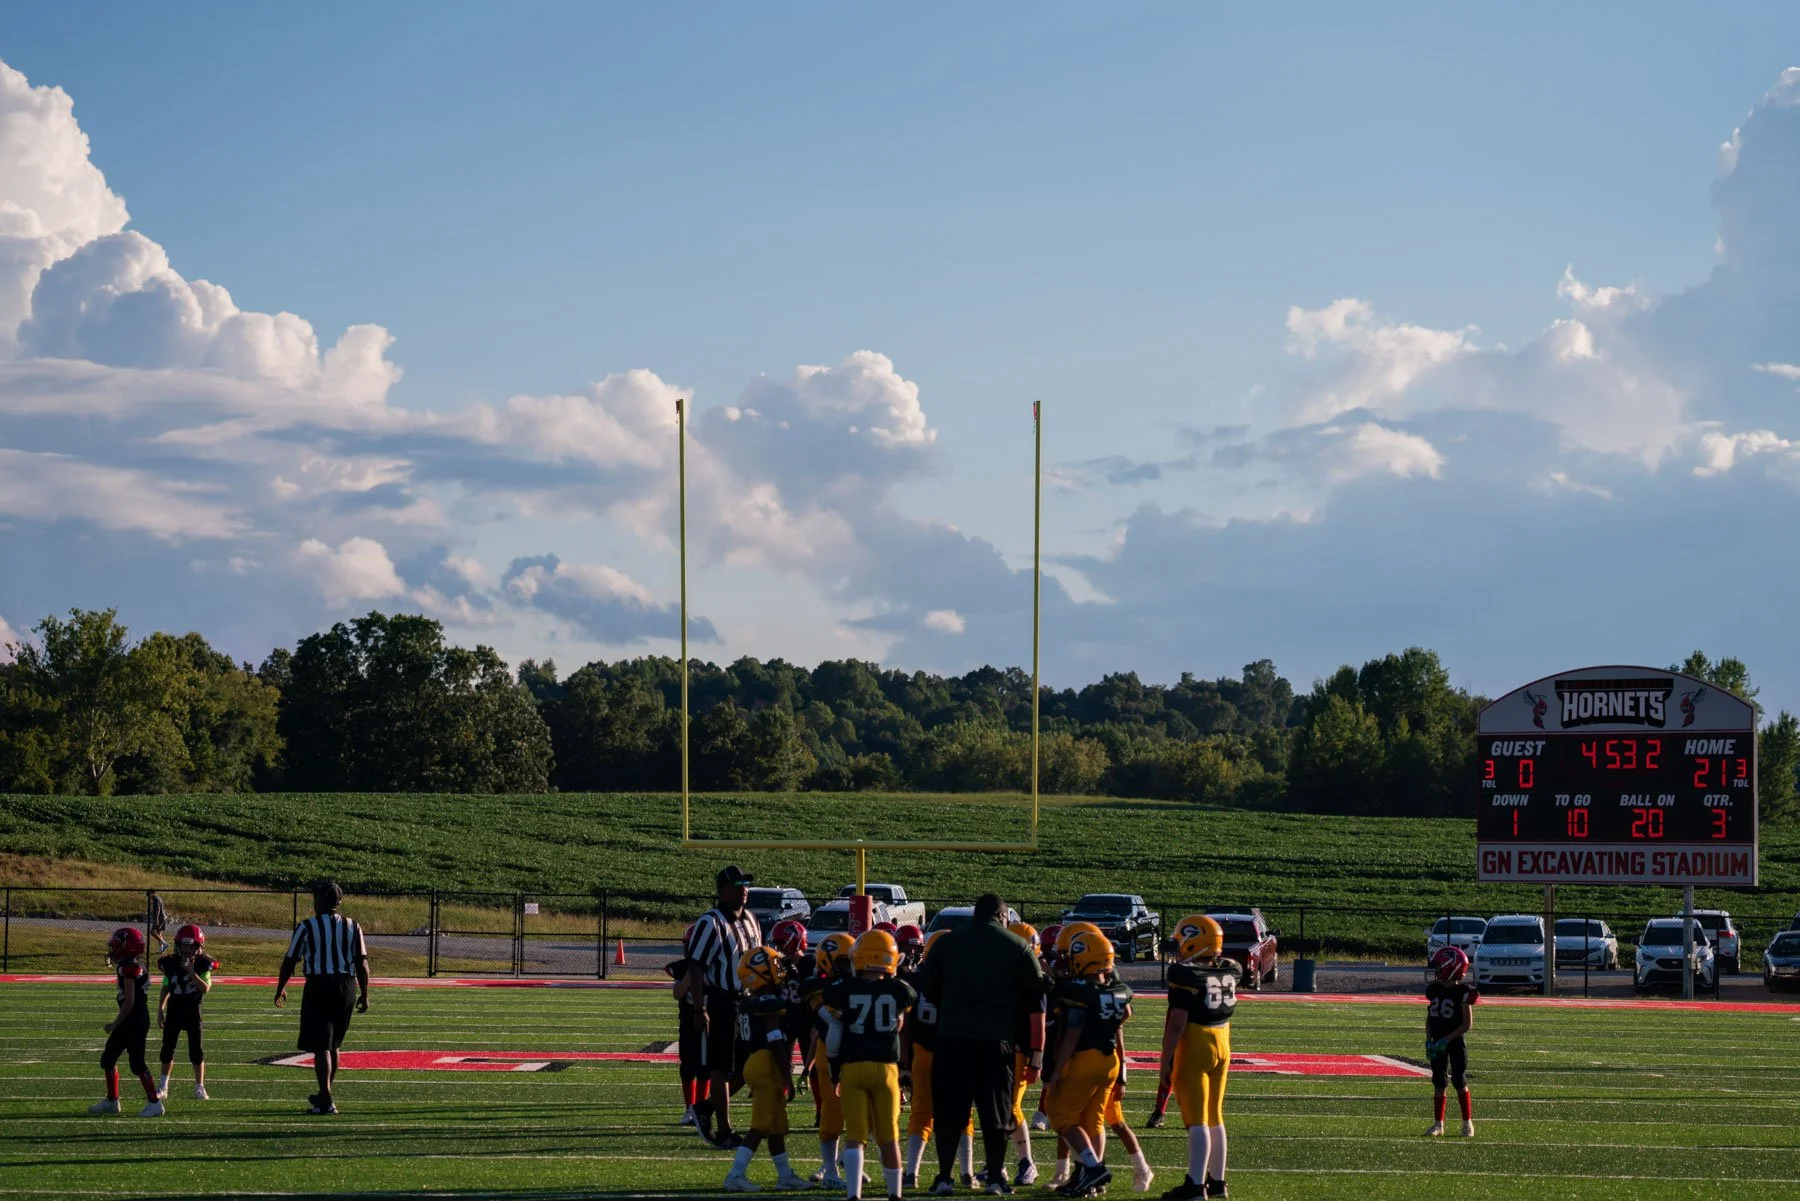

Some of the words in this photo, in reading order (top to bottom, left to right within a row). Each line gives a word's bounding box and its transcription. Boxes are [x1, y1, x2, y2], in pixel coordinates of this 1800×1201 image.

[1562, 690, 1665, 721] HORNETS
[1491, 741, 1546, 756] GUEST
[1684, 739, 1736, 755] HOME
[1485, 760, 1495, 779] 3
[1519, 759, 1534, 788] 0
[1694, 758, 1726, 788] 21
[1736, 759, 1746, 778] 3
[1481, 780, 1497, 788] TOL
[1733, 779, 1749, 788] TOL
[1492, 795, 1529, 806] DOWN
[1555, 795, 1570, 806] TO
[1573, 794, 1591, 806] GO
[1620, 794, 1652, 806] BALL
[1657, 794, 1675, 806] ON
[1703, 794, 1733, 807] QTR.
[1513, 809, 1518, 836] 1
[1567, 808, 1588, 837] 10
[1632, 808, 1663, 838] 20
[1711, 809, 1726, 838] 3
[1482, 851, 1512, 874] GN
[1517, 851, 1646, 876] EXCAVATING
[1652, 852, 1748, 877] STADIUM
[848, 994, 897, 1034] 70
[1429, 996, 1454, 1019] 26
